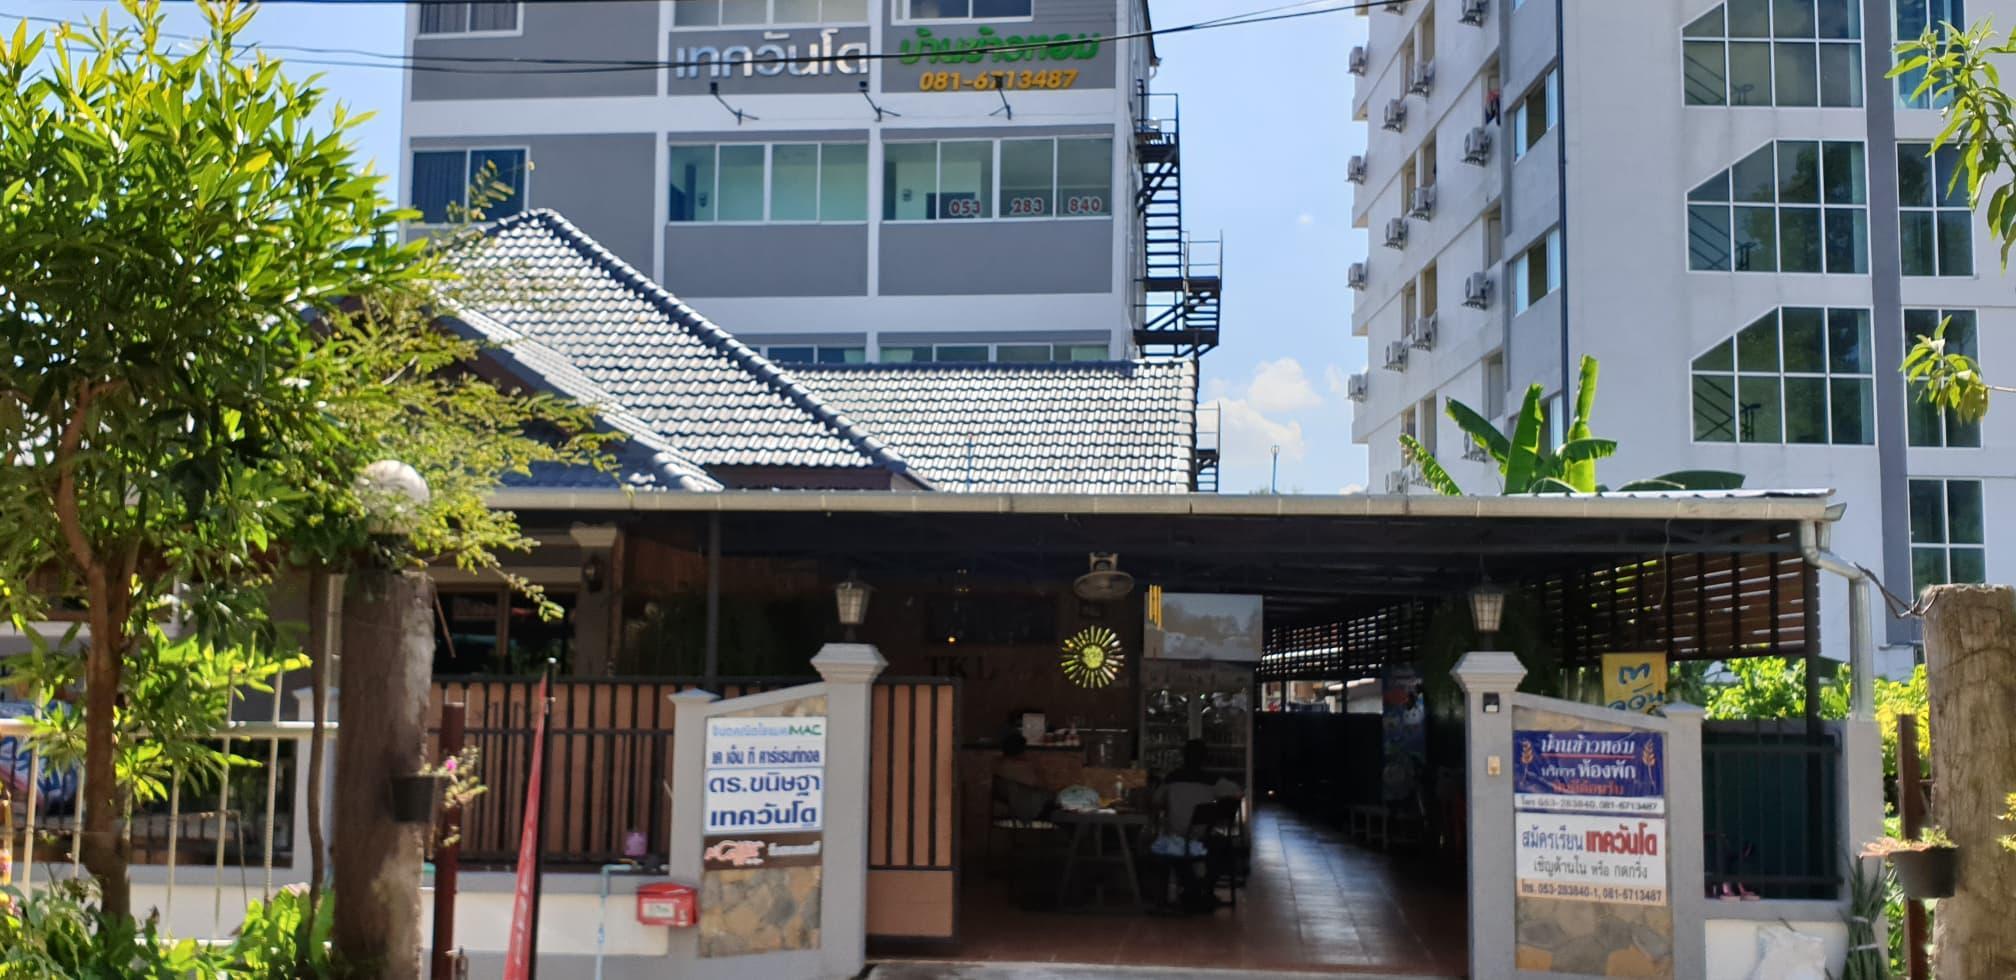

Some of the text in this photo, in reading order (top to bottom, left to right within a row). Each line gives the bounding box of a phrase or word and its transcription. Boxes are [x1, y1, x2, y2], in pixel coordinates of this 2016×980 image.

[675, 28, 869, 78] เทควันโด
[899, 26, 1101, 65] บ้านข้าวหอม
[949, 196, 1102, 216] 053 283 840
[1540, 733, 1635, 754] บ้านข้าวหอม
[1577, 759, 1636, 779] ห้องพัก
[709, 771, 820, 796] ดร.ขนิษฐา
[710, 800, 817, 826] เทควันโด
[1522, 822, 1658, 856] สมัครเรียน เทควันโด
[1533, 855, 1587, 878] เชิญด้านใน
[1591, 860, 1610, 877] หรือ
[1602, 887, 1662, 902] 081-6713487
